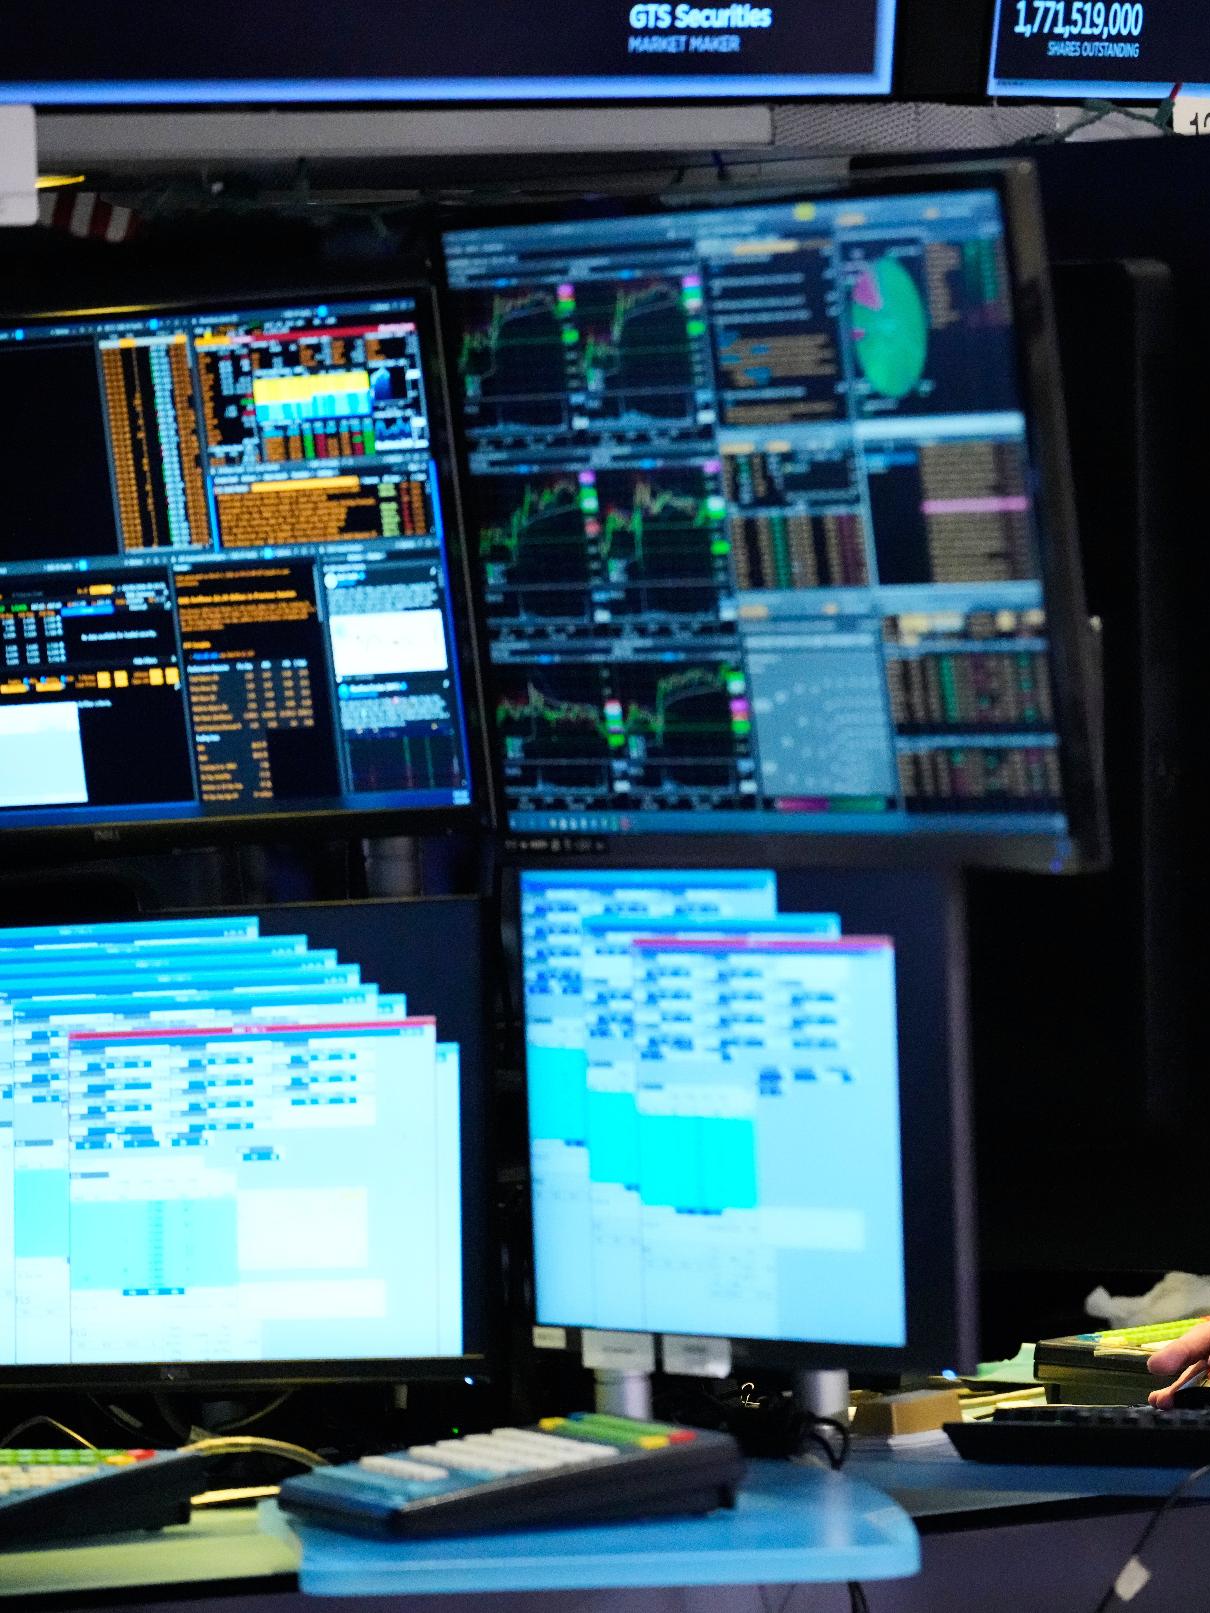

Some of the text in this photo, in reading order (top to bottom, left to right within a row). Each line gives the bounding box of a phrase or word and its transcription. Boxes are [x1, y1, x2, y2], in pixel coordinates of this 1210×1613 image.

[628, 3, 773, 29] GTS Securities
[1013, 1, 1144, 39] 1,771,519,000
[627, 34, 741, 53] MARKET MAKER
[1047, 40, 1140, 58] SHARES OUTSTANDING
